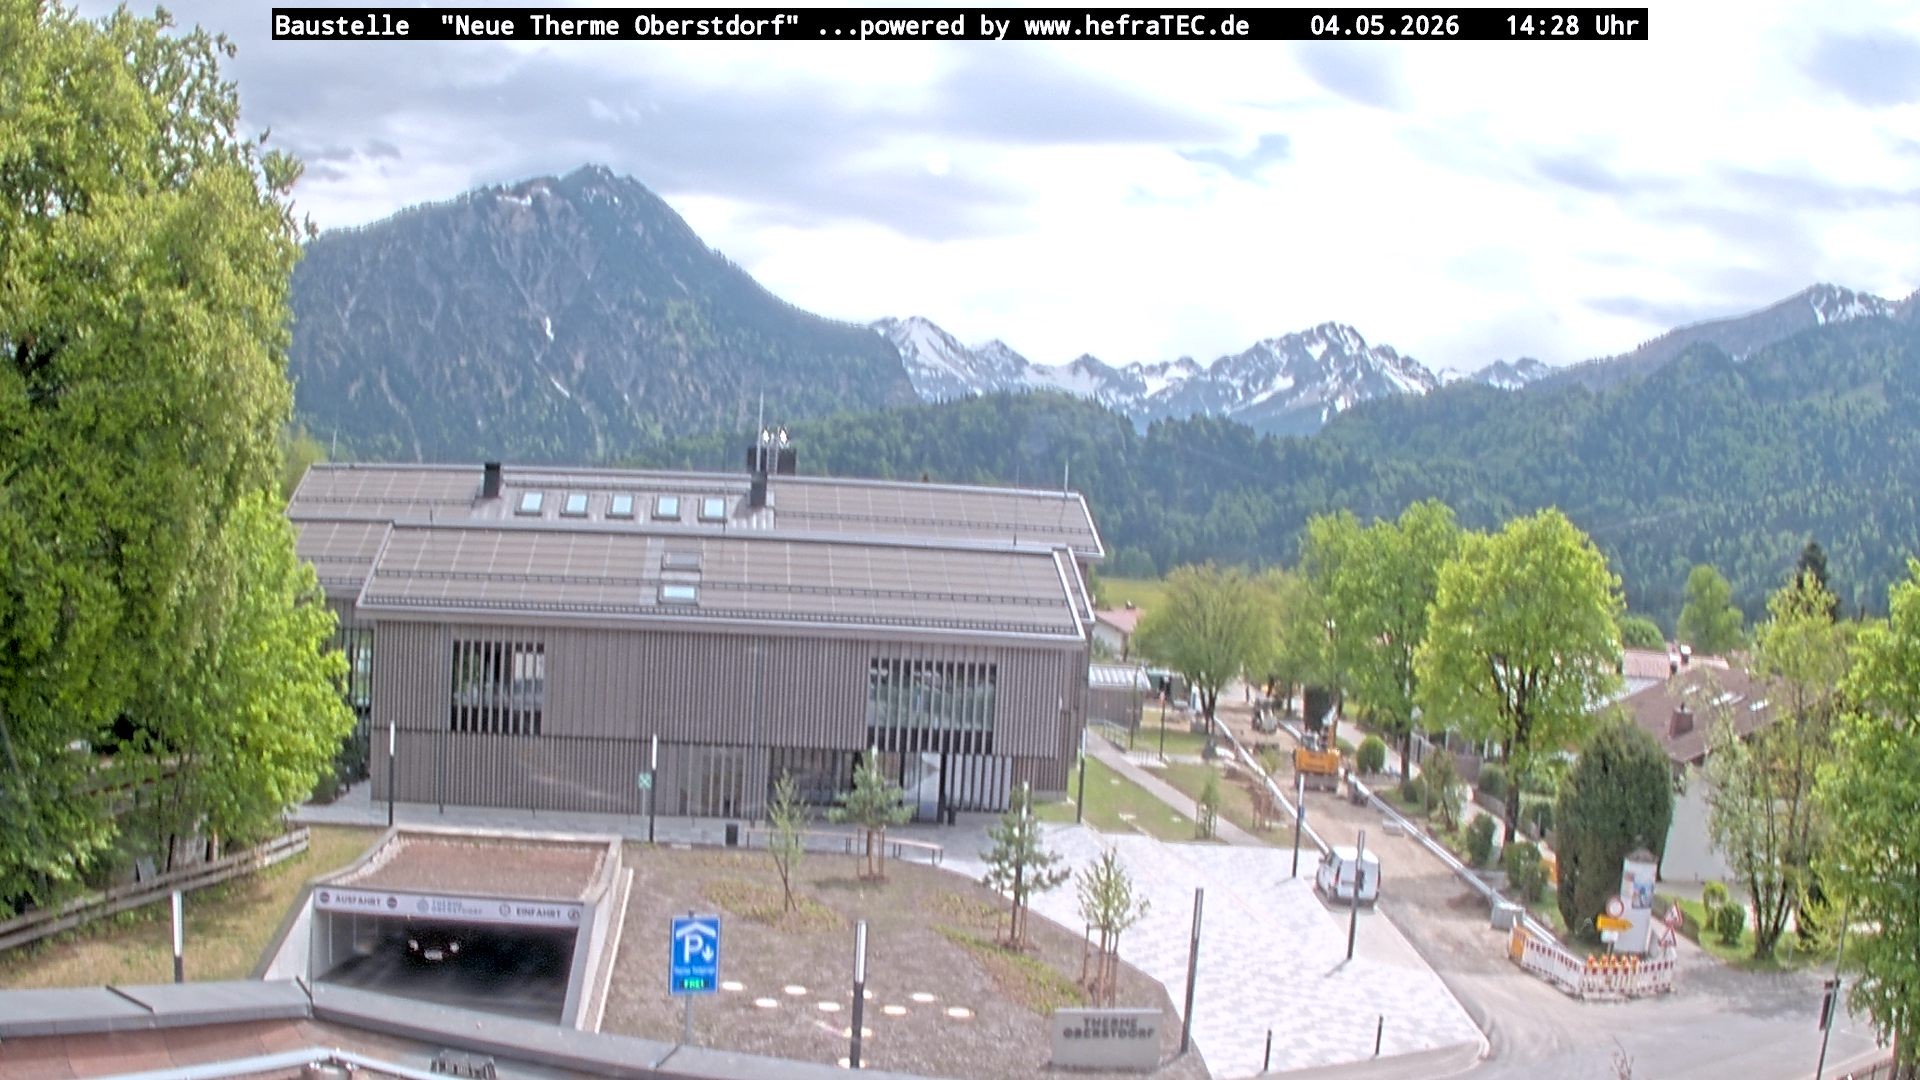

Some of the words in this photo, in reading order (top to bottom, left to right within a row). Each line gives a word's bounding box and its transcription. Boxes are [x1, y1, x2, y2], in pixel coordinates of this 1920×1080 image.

[335, 895, 381, 906] AUSFAHRT
[515, 907, 561, 919] EINFAHRT
[684, 934, 703, 963] P
[1083, 1018, 1138, 1029] THERME
[1063, 1027, 1155, 1039] OBERSTDORF
